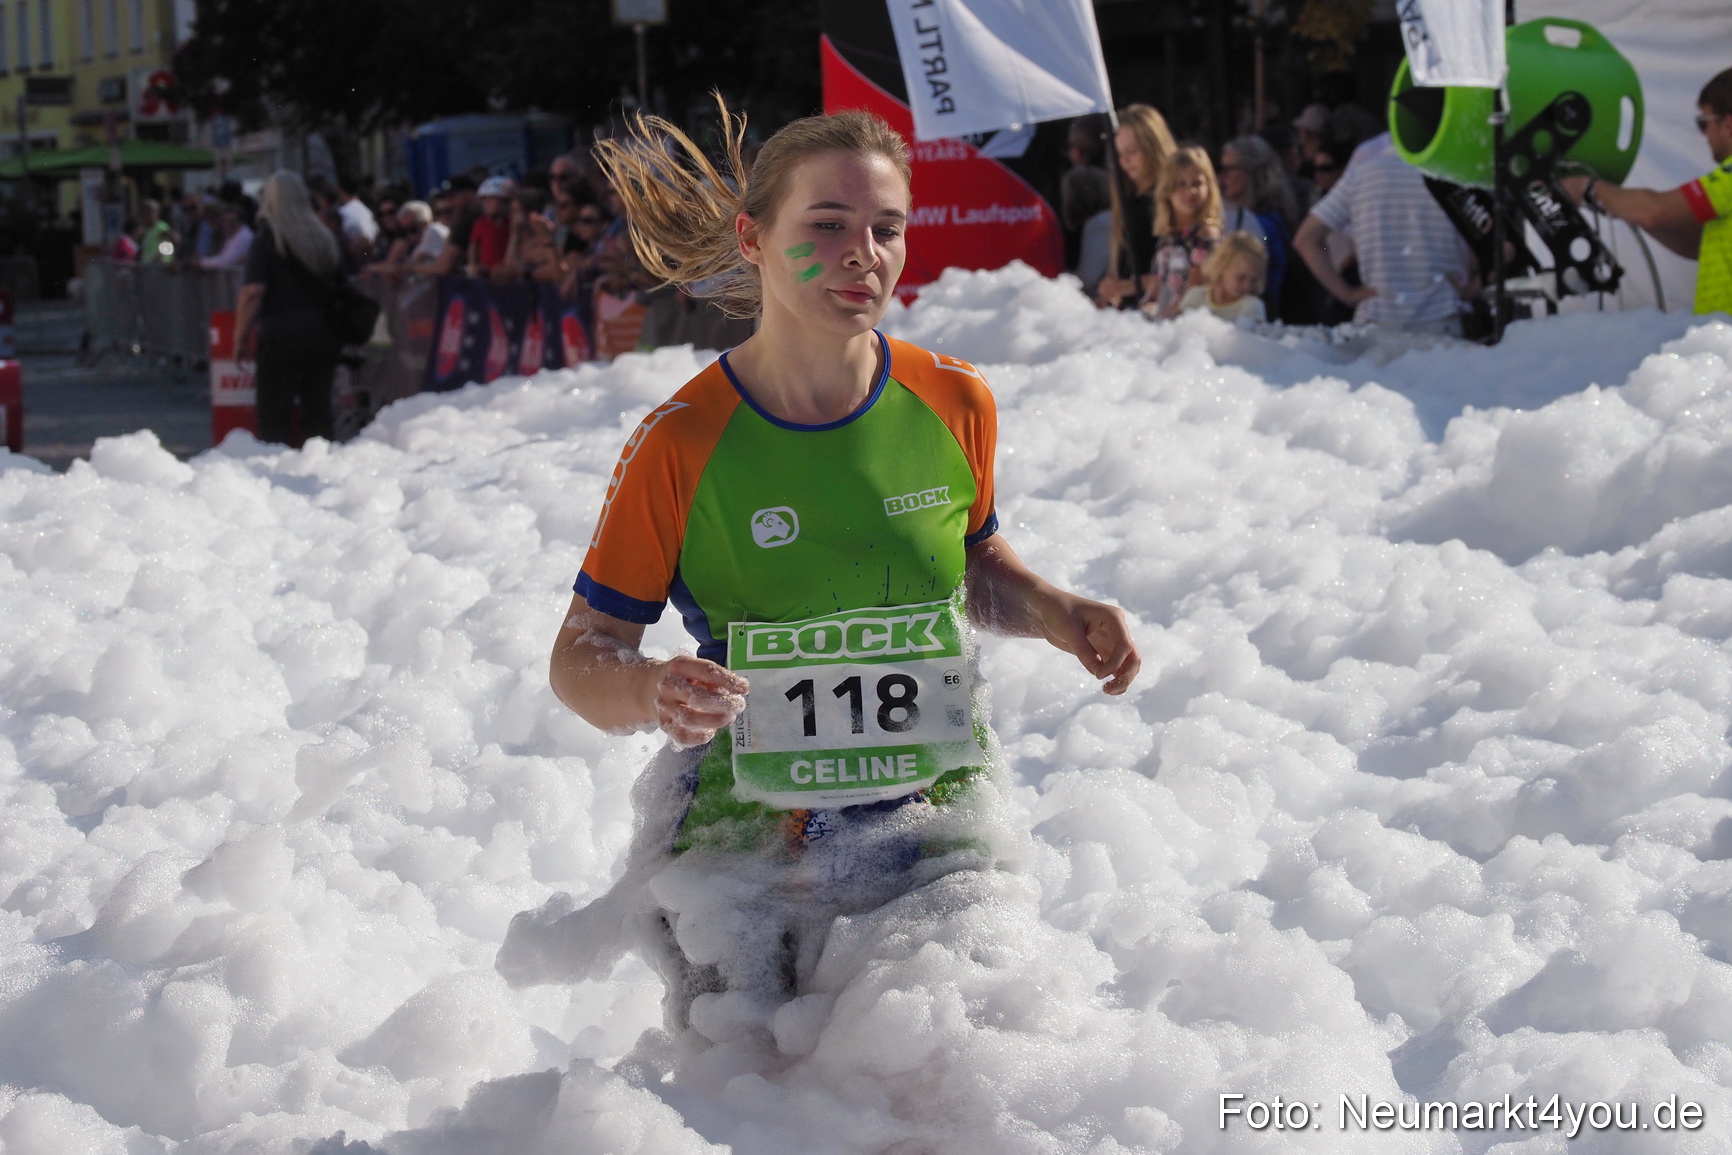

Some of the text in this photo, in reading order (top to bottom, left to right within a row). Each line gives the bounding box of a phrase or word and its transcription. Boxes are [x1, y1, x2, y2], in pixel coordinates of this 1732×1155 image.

[917, 146, 968, 162] YEARS
[952, 202, 1043, 226] Laufsport
[884, 486, 951, 516] BOCK
[748, 612, 944, 661] BOCK
[944, 675, 960, 685] E6
[785, 673, 921, 737] 118
[790, 754, 917, 784] CELINE
